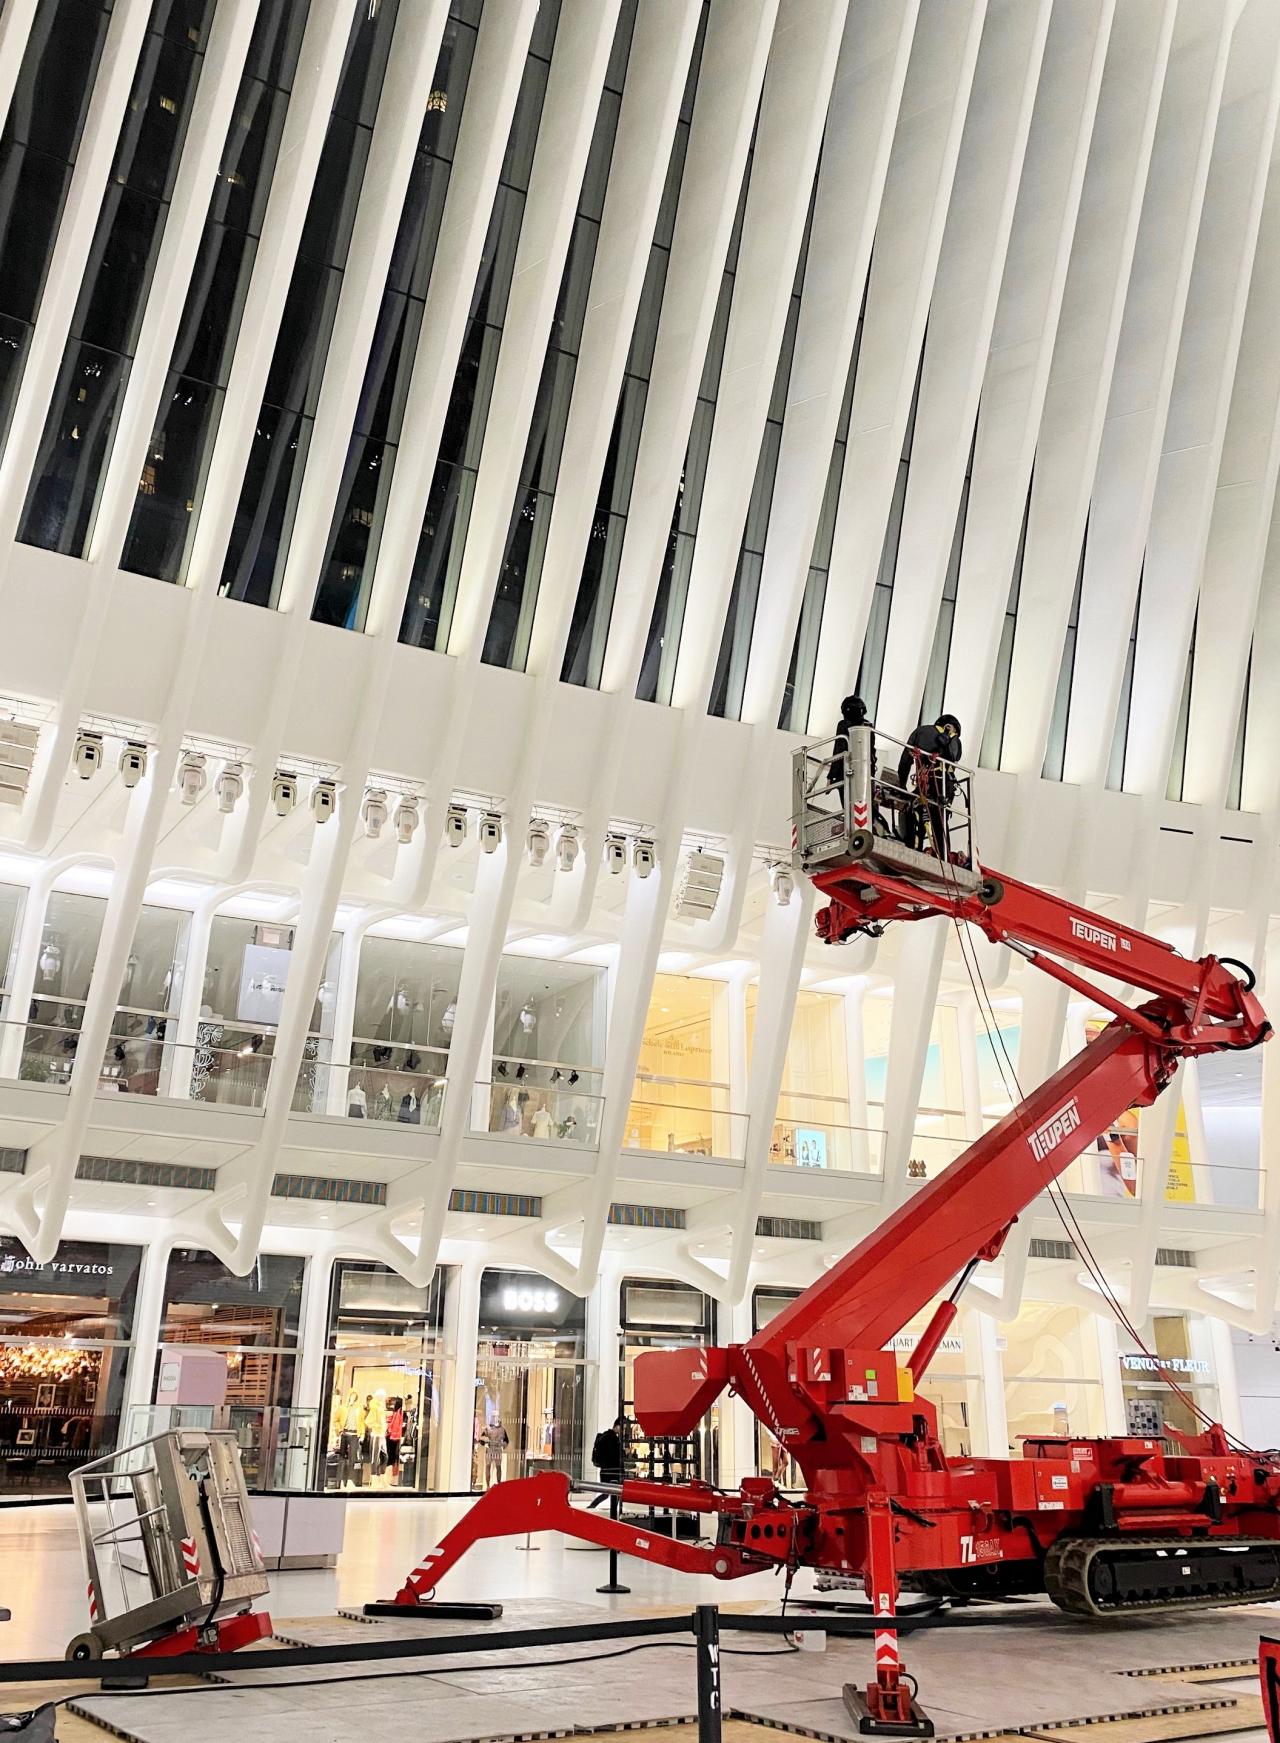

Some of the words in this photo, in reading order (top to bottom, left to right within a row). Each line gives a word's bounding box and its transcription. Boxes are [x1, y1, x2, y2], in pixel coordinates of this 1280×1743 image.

[1069, 916, 1116, 952] TEUPEN
[1027, 1098, 1081, 1163] TEUPEN
[52, 1262, 113, 1275] varvatos
[504, 1290, 558, 1312] BOSS
[1172, 1359, 1209, 1372] FLEUR
